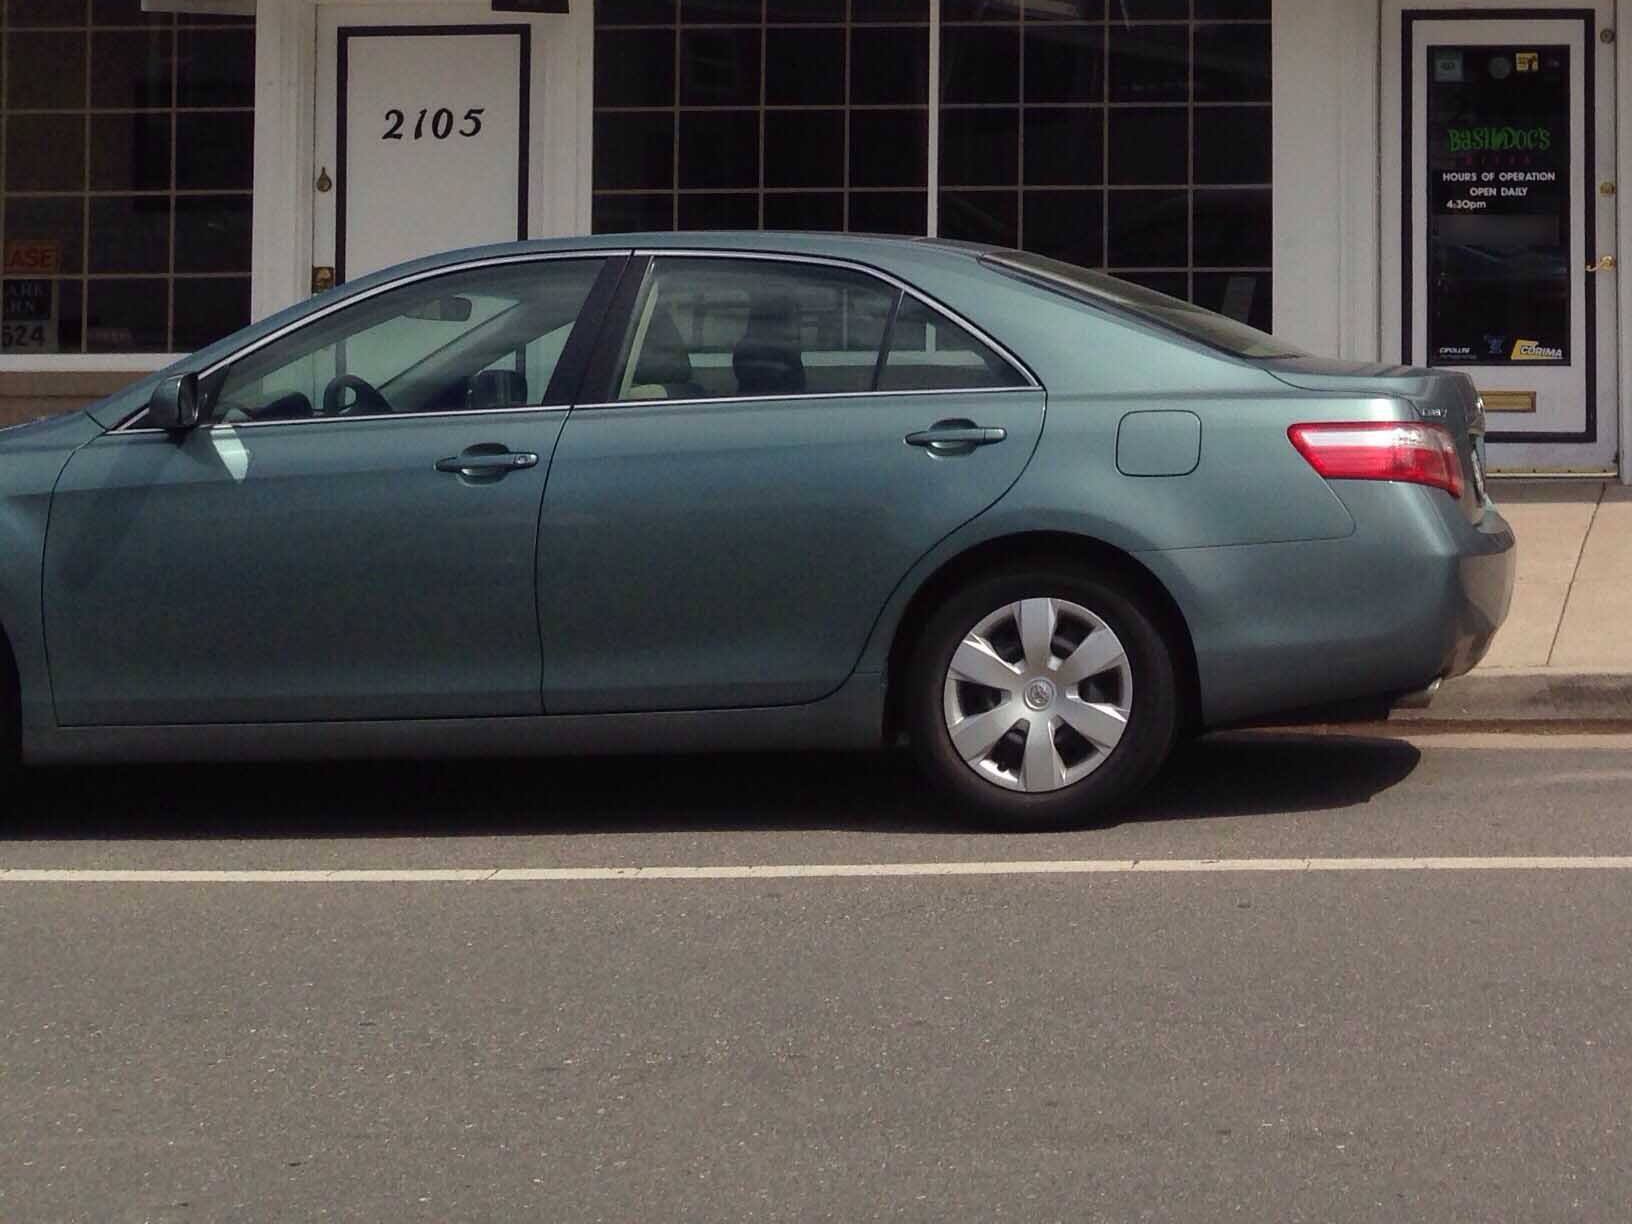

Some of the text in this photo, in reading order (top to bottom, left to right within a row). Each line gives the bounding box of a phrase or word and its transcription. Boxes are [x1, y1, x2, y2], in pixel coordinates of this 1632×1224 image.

[382, 108, 485, 140] 2105
[1443, 171, 1556, 181] HOURS OF OPERATION
[1469, 186, 1528, 197] OPEN DAILY
